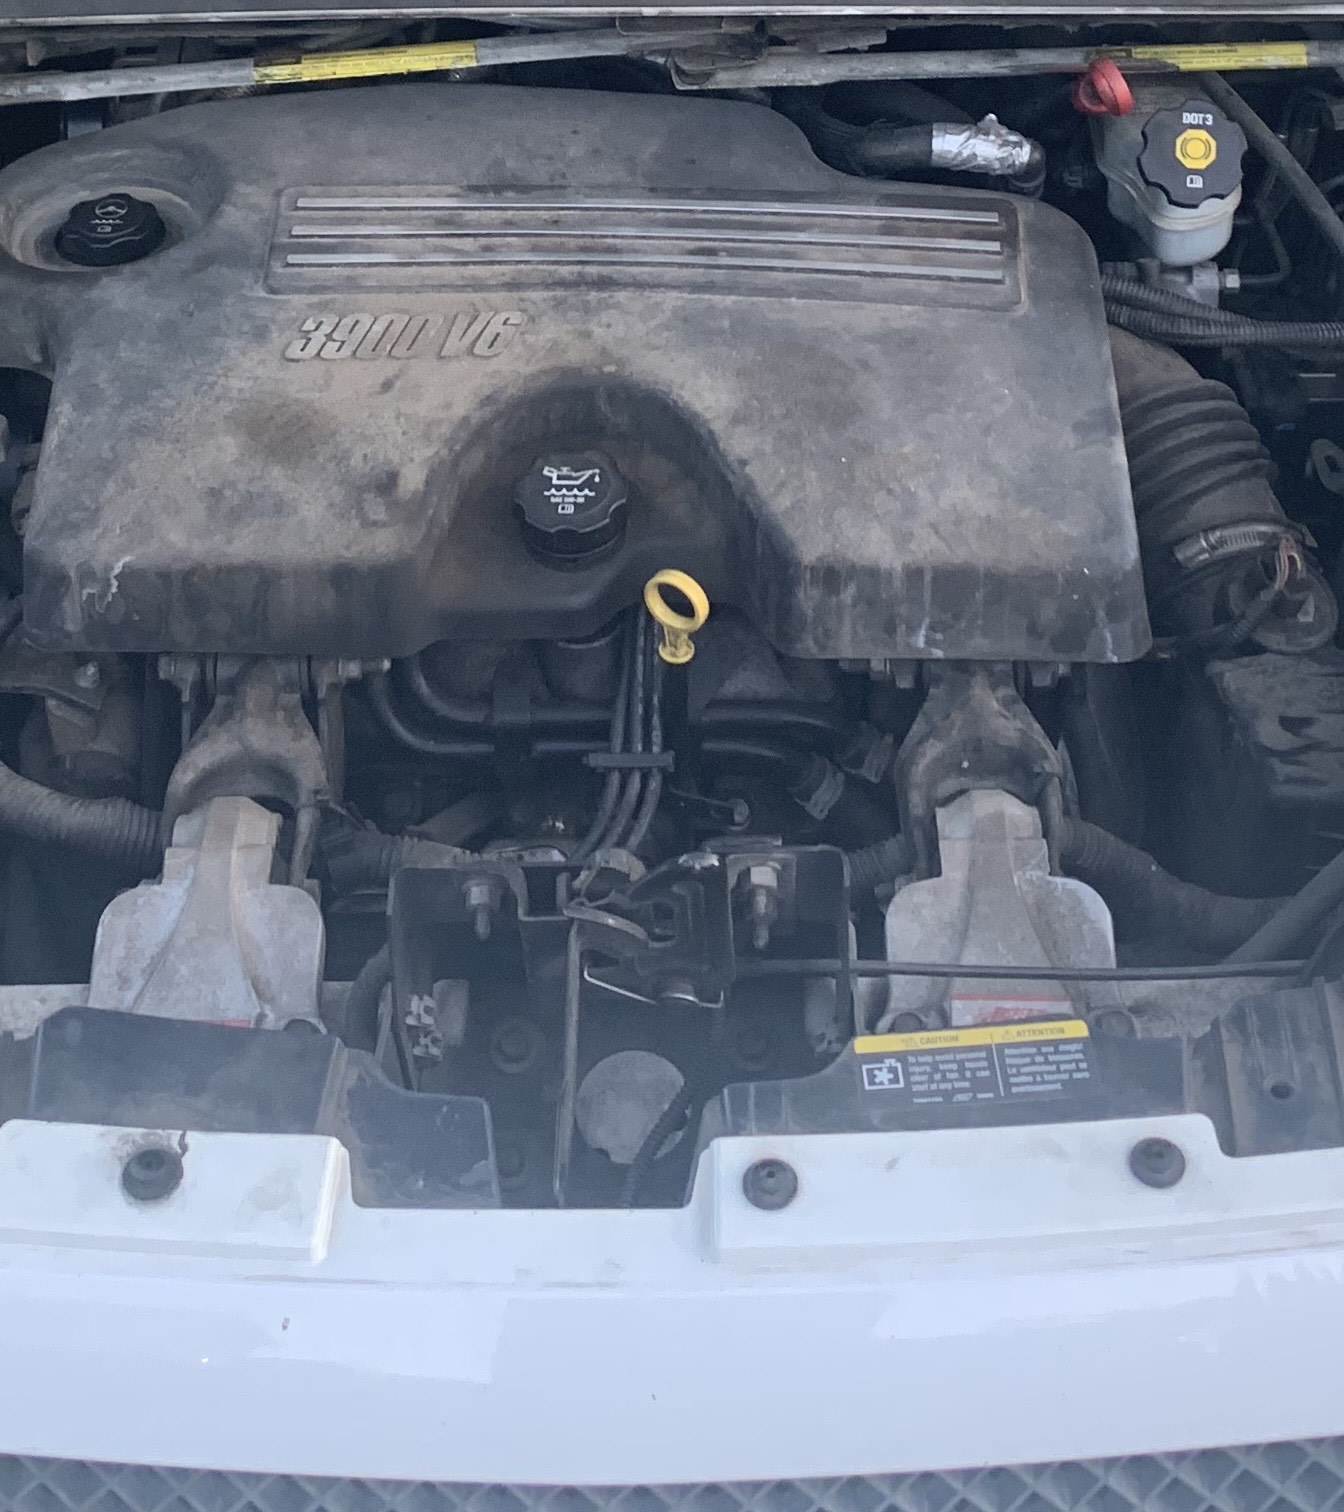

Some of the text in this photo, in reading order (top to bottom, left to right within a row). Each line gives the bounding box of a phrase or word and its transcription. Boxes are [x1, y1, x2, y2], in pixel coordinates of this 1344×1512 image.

[283, 311, 528, 361] 3900 V6
[919, 1027, 1065, 1046] CAUTION ATTENTION
